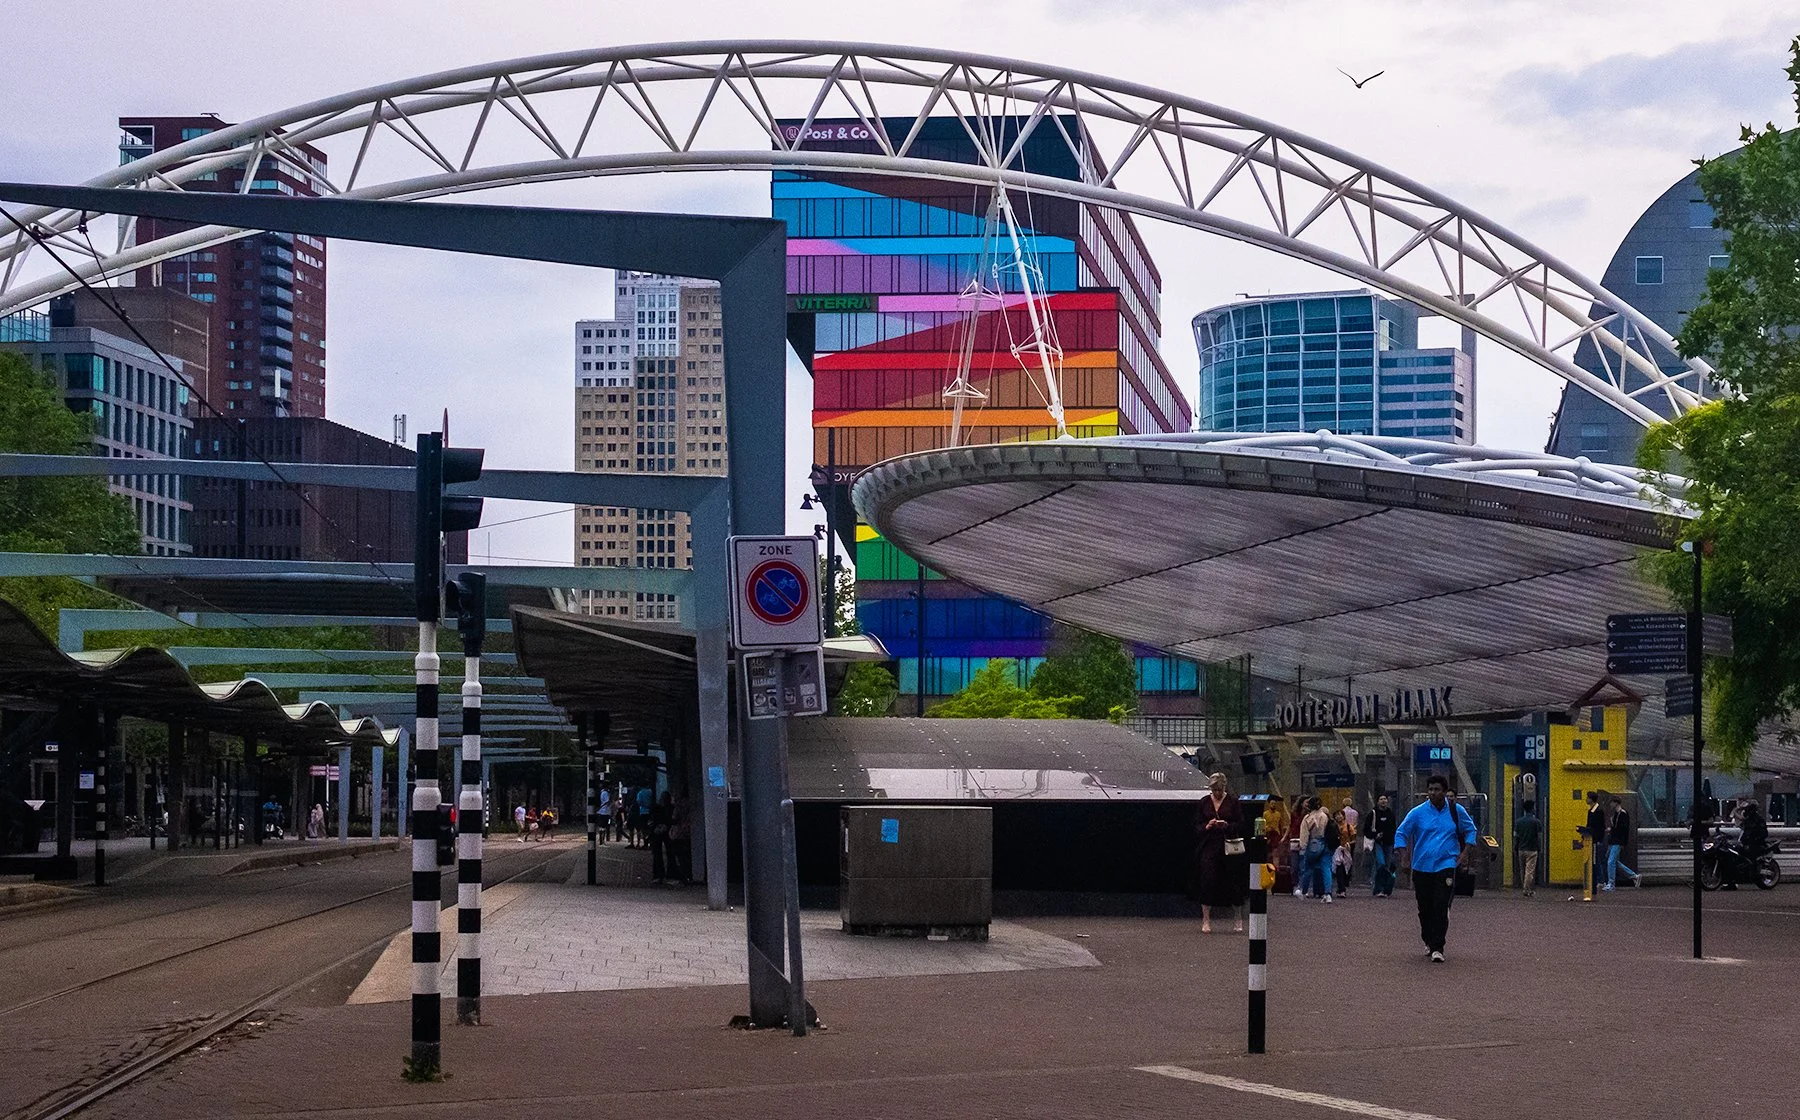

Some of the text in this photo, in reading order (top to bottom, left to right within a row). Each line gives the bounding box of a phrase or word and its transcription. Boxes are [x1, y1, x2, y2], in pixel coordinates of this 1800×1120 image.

[803, 127, 869, 139] Post & Co
[796, 296, 871, 310] VITERRA
[759, 545, 793, 556] ZONE
[1275, 686, 1450, 729] ROTTERDAM BLAAK
